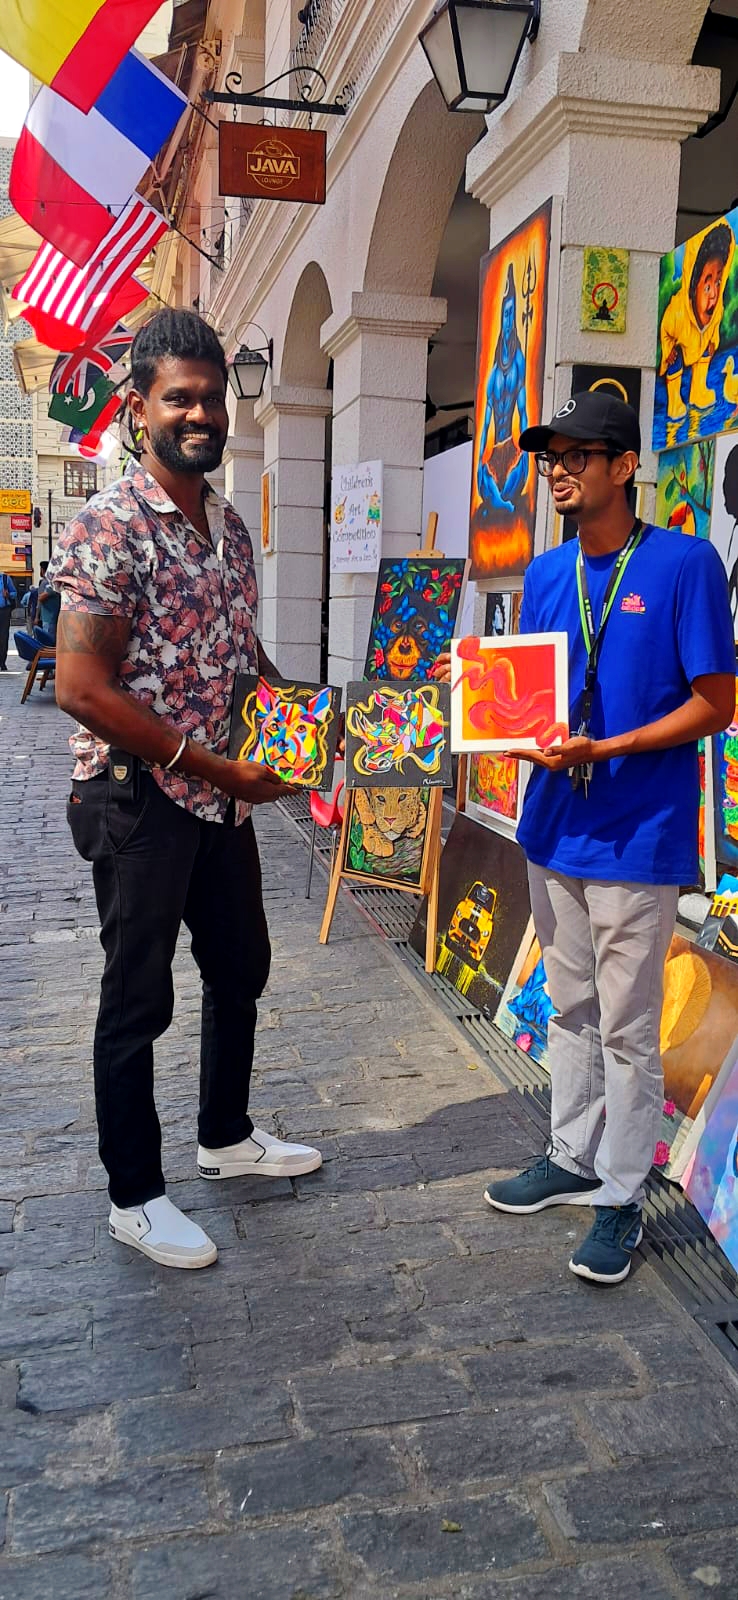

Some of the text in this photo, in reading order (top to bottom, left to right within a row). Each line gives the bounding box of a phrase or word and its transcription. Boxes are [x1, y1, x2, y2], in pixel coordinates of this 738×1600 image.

[250, 158, 296, 175] JAVA
[340, 473, 373, 491] Children's
[349, 504, 361, 517] Art
[333, 528, 376, 543] Competition
